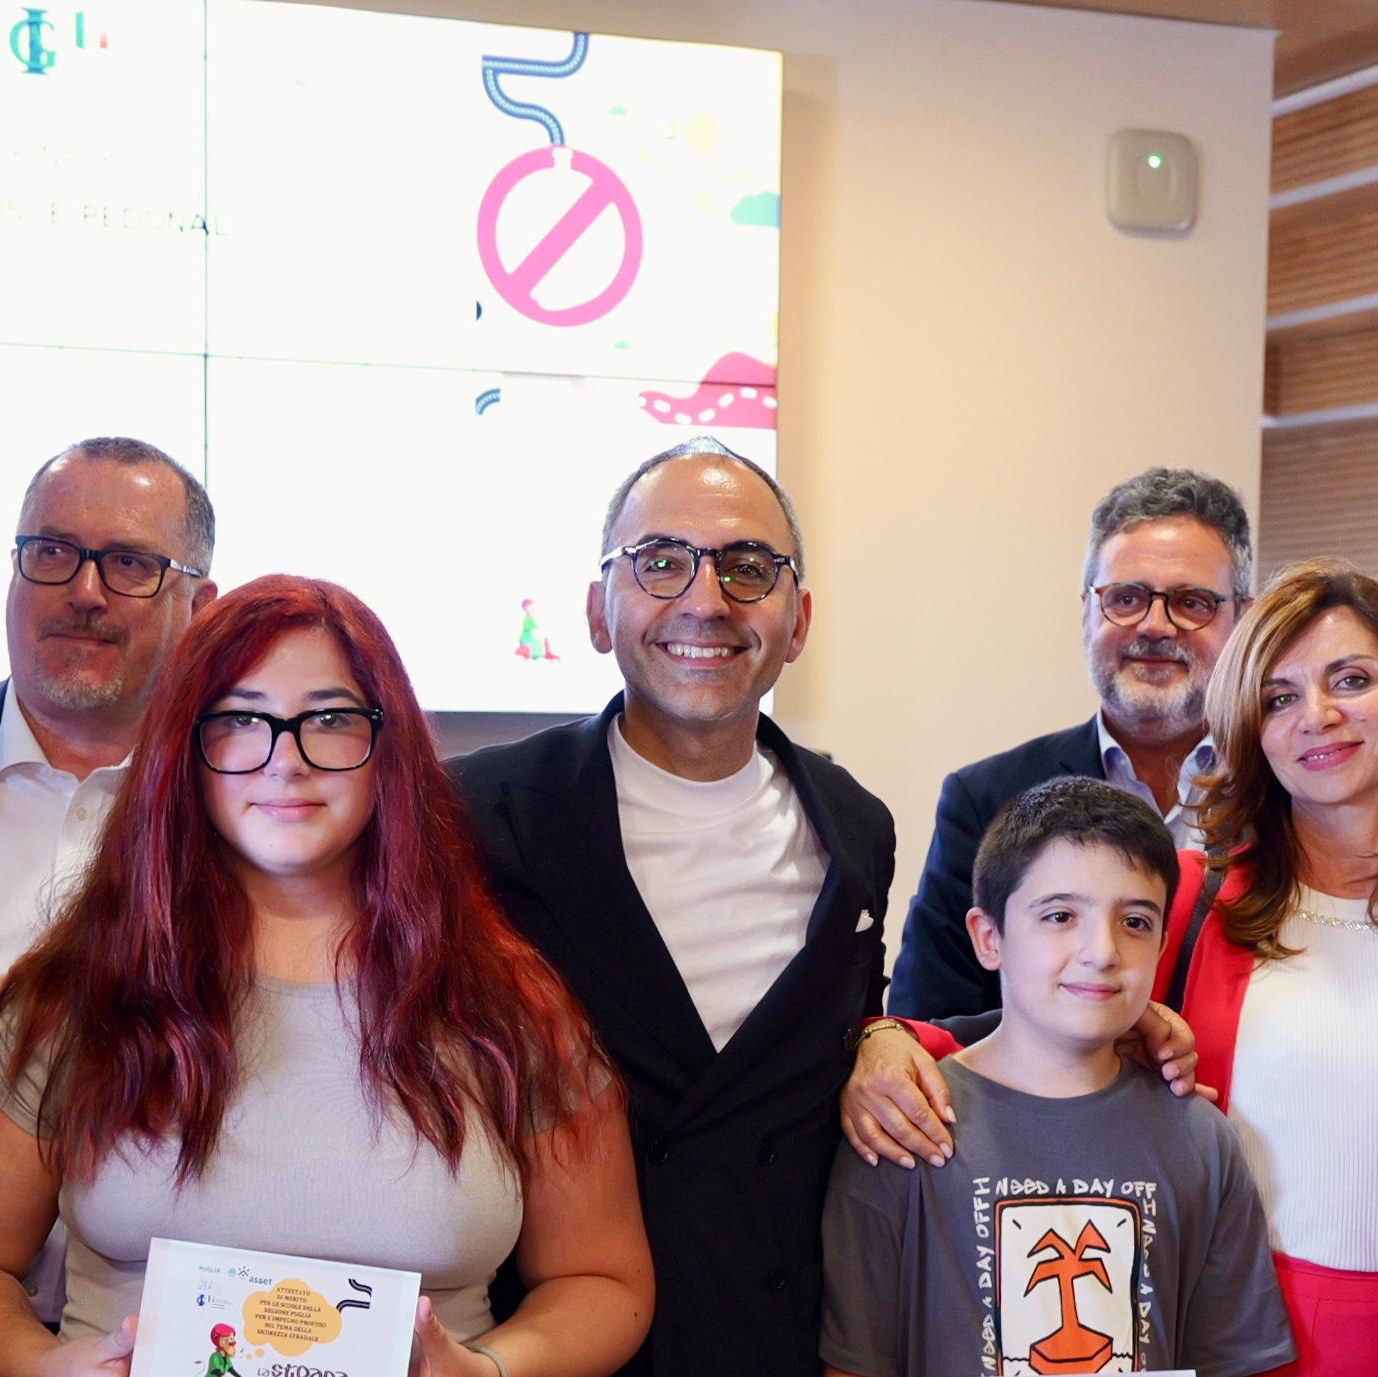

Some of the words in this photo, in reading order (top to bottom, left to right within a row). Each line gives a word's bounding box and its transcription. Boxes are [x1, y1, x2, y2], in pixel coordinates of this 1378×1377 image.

[1072, 1177, 1114, 1198] DAY
[1120, 1180, 1157, 1199] OFF
[972, 1195, 991, 1239] OFF
[976, 1244, 996, 1289] DAY
